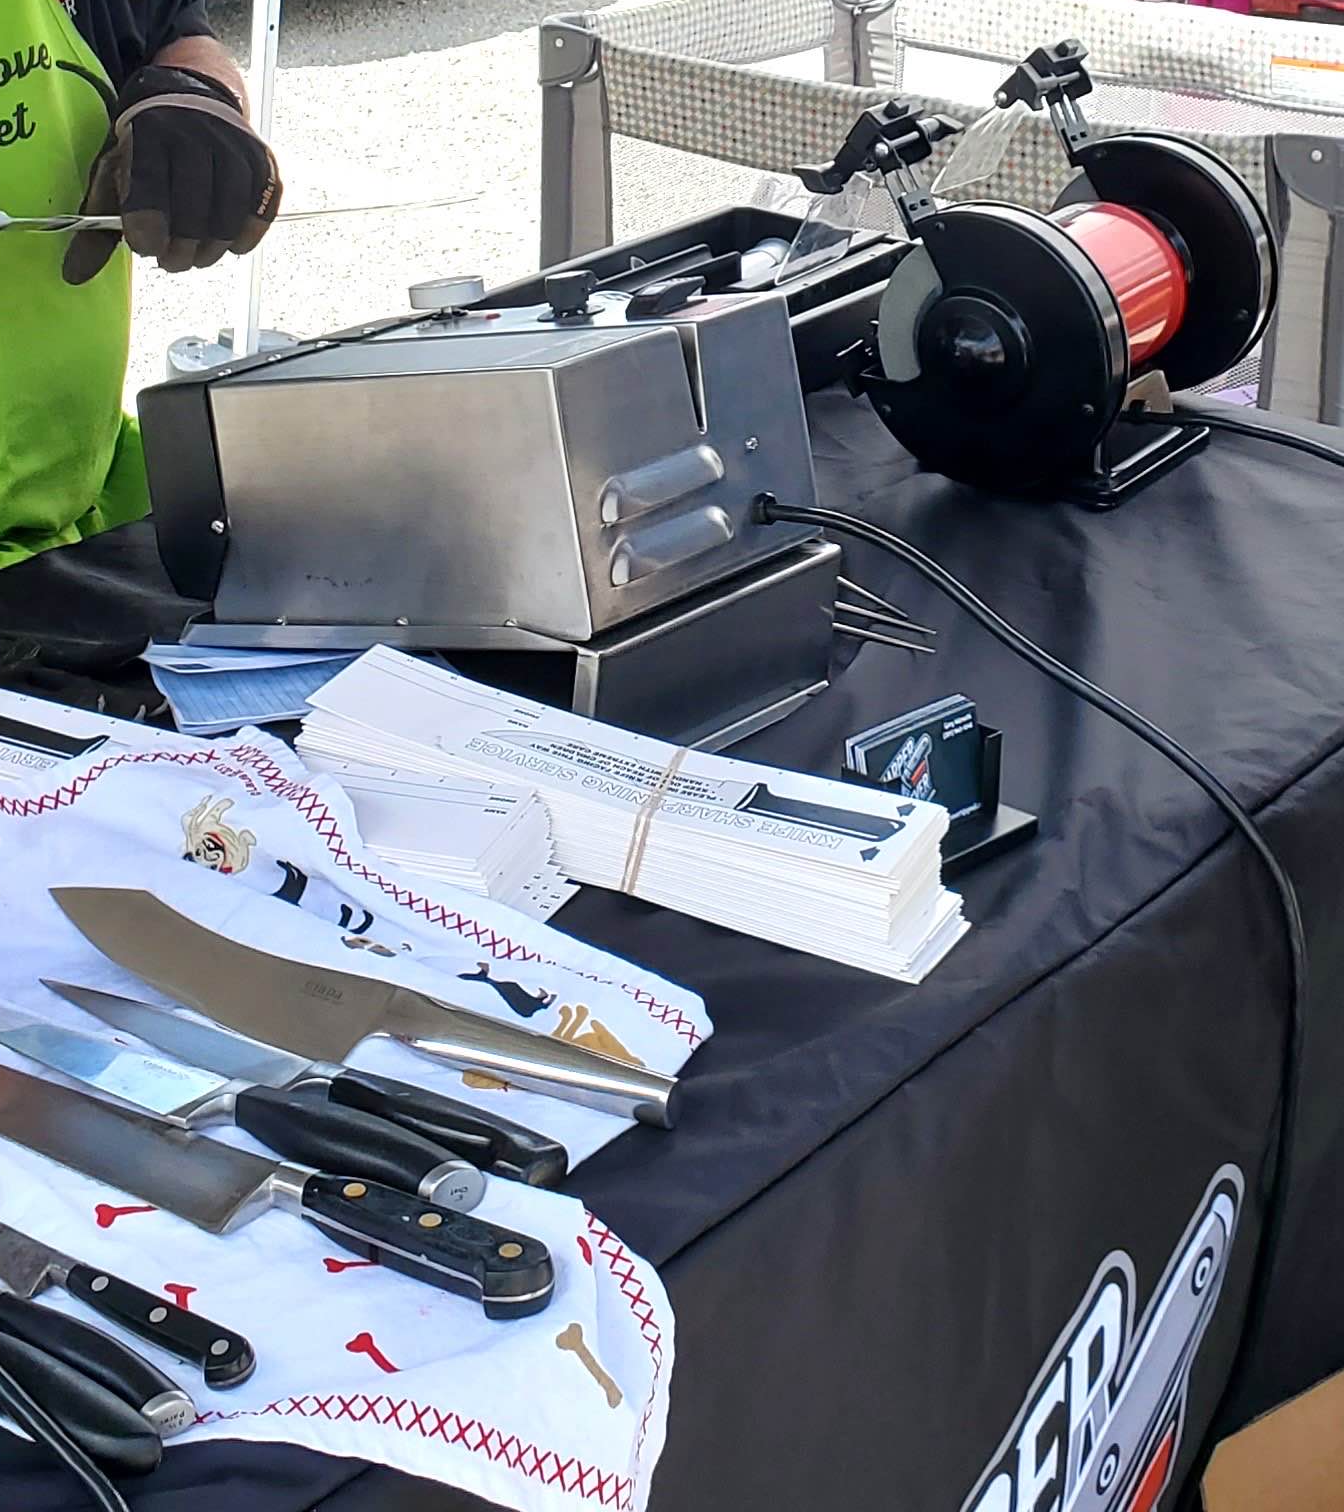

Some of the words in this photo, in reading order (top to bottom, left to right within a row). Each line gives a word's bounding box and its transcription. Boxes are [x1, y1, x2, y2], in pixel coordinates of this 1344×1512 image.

[465, 737, 577, 781] SERVICE
[582, 776, 756, 829] SHARPNING
[756, 822, 844, 849] KNIFE
